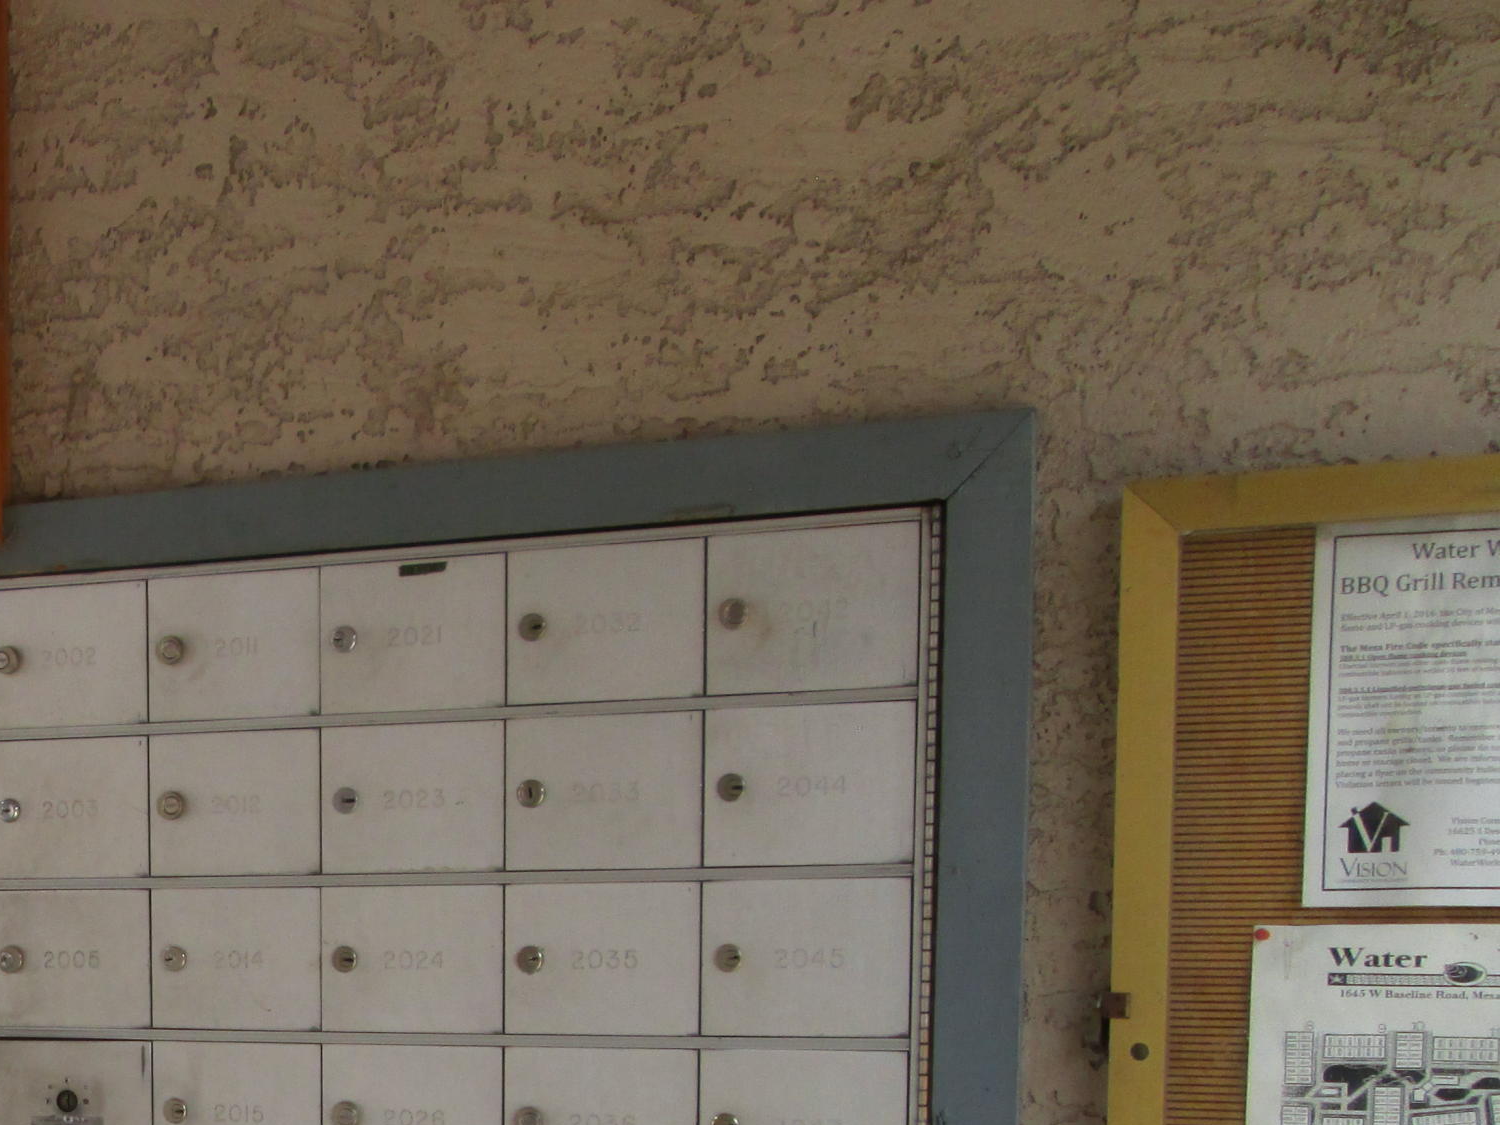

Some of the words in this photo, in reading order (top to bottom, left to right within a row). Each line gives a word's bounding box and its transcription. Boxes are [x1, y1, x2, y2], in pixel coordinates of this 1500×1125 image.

[1412, 542, 1481, 560] Water
[1340, 575, 1389, 597] BBQ
[1396, 572, 1443, 592] Grill
[388, 624, 442, 647] 2021
[215, 637, 257, 657] 2011
[1340, 644, 1357, 653] The
[1386, 643, 1404, 651] Fire
[1406, 642, 1428, 650] Code
[1431, 639, 1482, 649] specifically
[778, 775, 846, 797] 2044
[383, 788, 445, 809] 2023
[42, 799, 98, 820] 2003
[213, 950, 263, 969] 2014
[383, 950, 444, 969] 2024
[572, 949, 638, 970] 2035
[774, 948, 844, 969] 2045
[1329, 947, 1428, 969] Water
[1340, 989, 1365, 999] 1645
[1369, 990, 1382, 999] W
[1384, 989, 1432, 1000] Baseline
[1435, 990, 1470, 1001] Road,
[1378, 1023, 1388, 1034] 9
[214, 1104, 264, 1123] 2015
